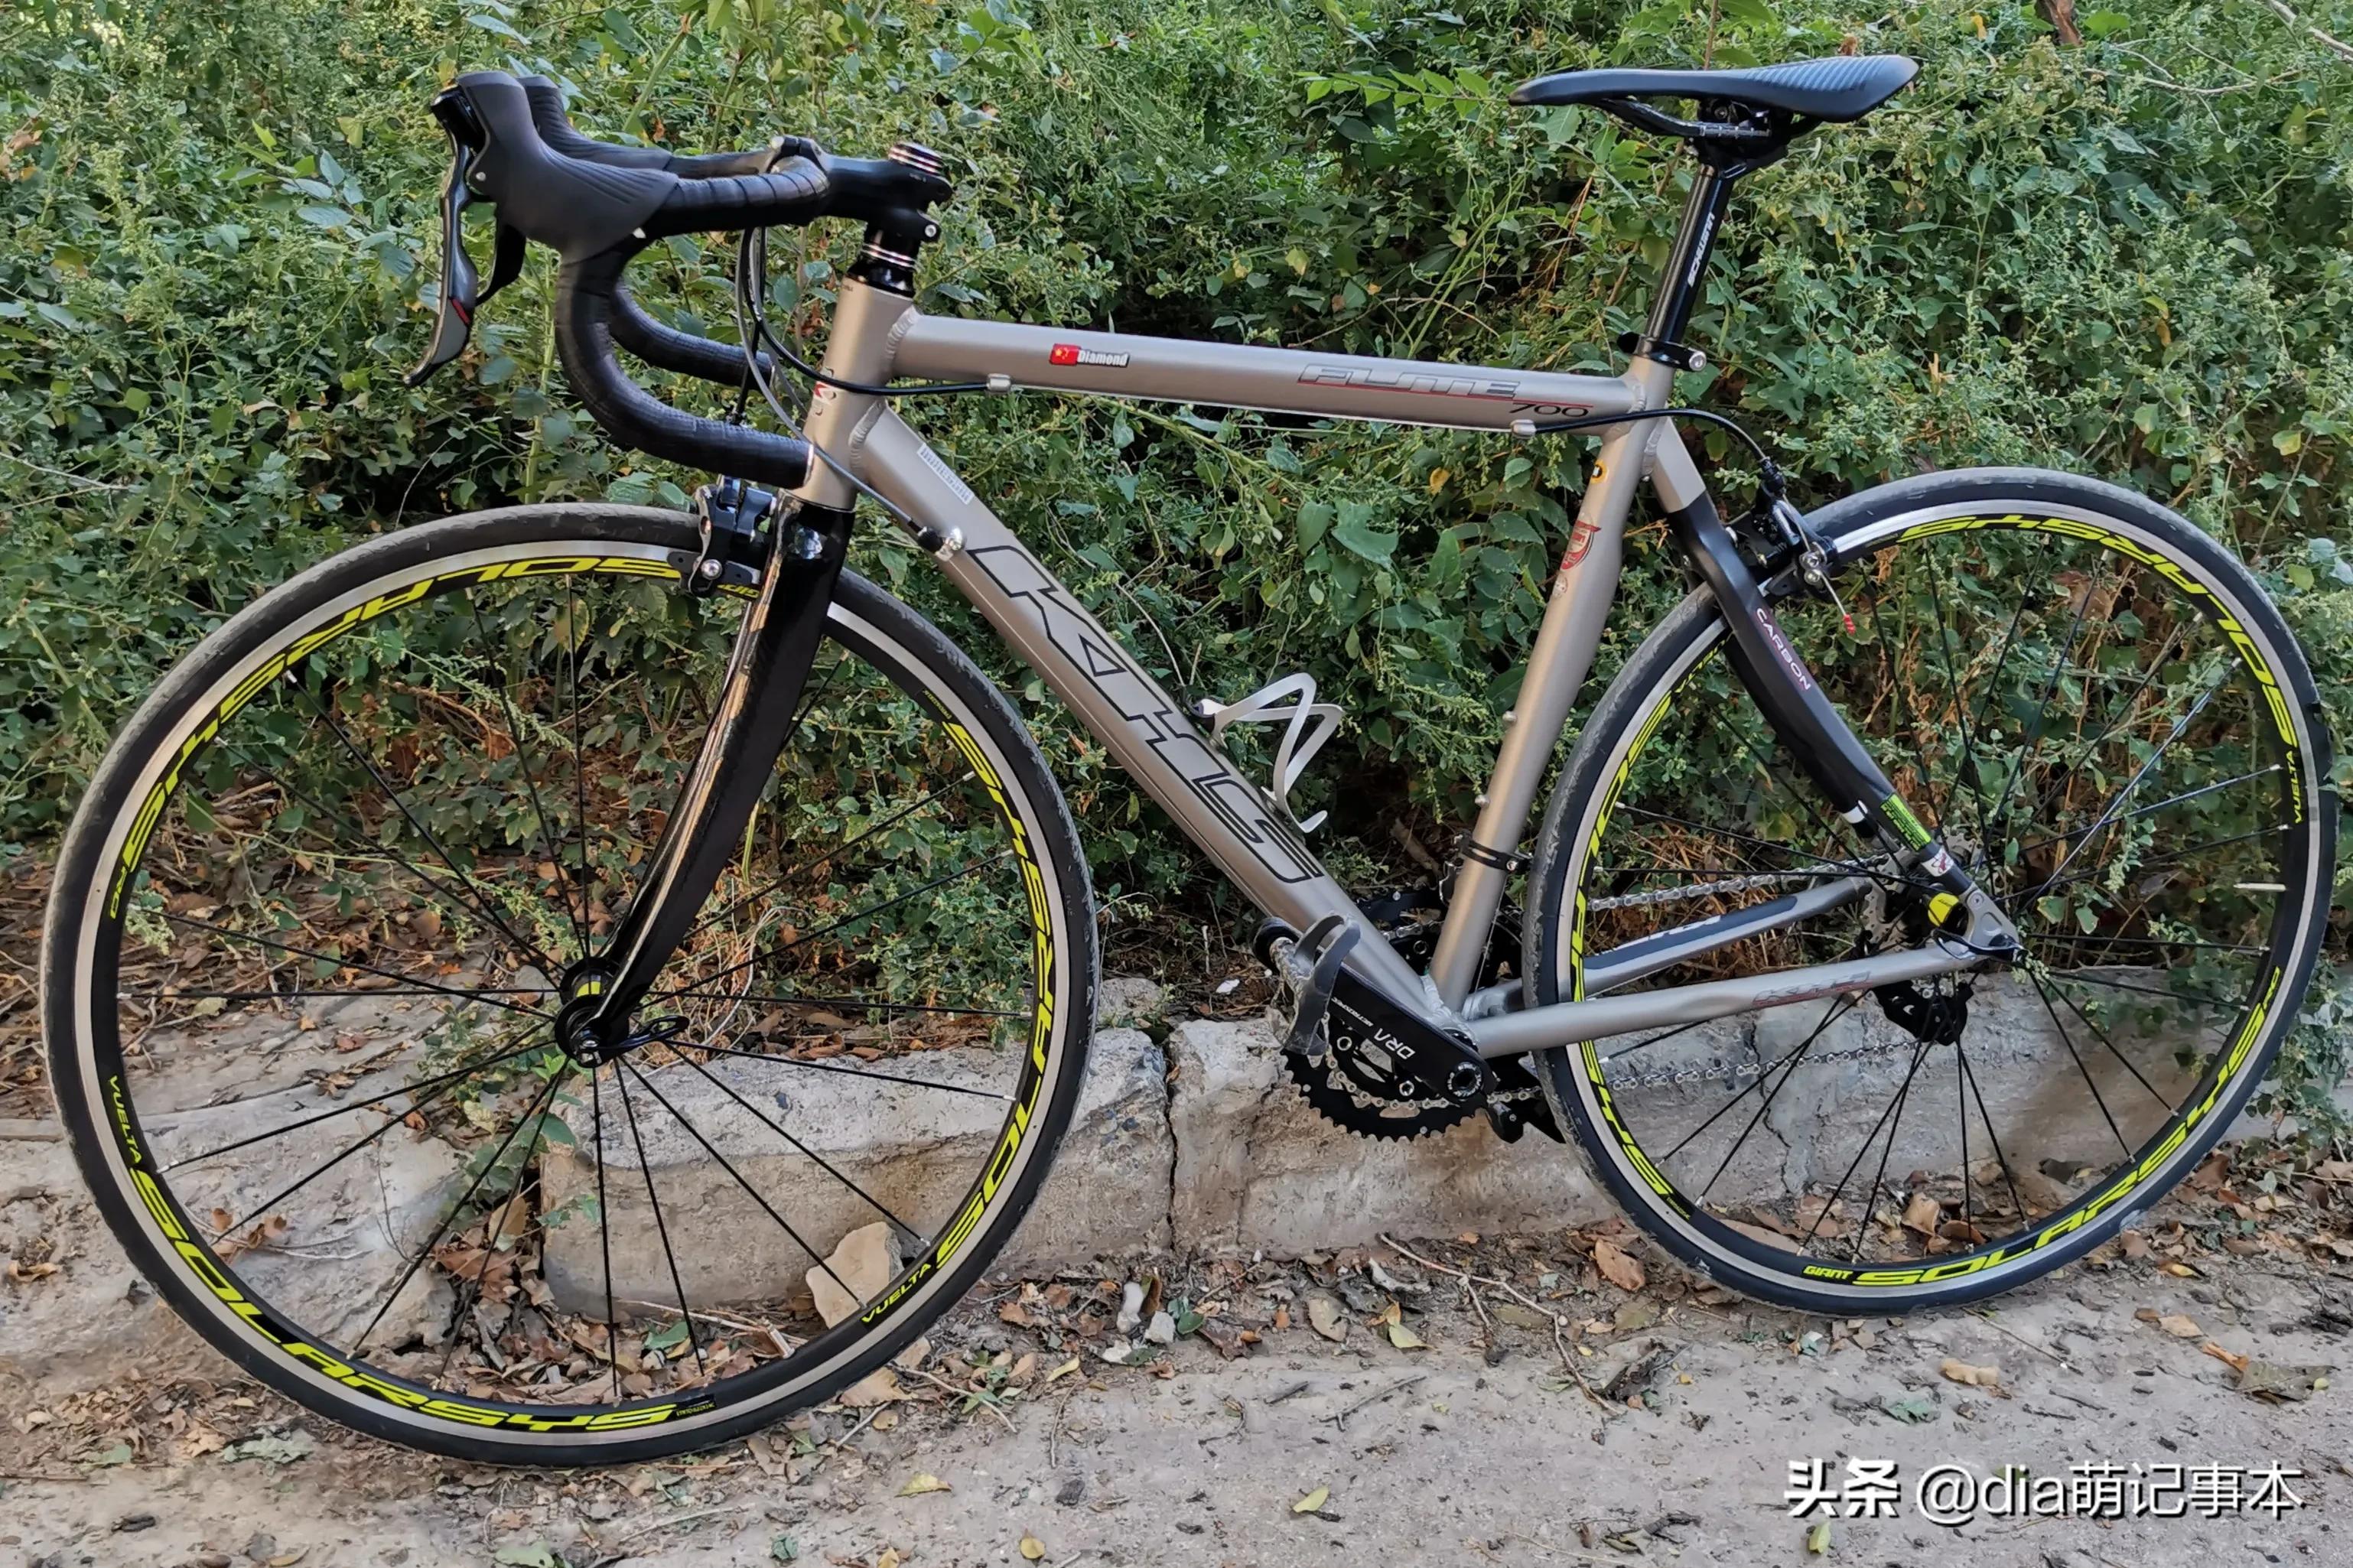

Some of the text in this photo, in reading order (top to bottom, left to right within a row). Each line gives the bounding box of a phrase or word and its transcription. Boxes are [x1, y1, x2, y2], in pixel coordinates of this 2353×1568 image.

[1077, 350, 1129, 367] Diamond
[1508, 402, 1589, 418] 700
[1756, 608, 1811, 690] CARBON
[2286, 750, 2303, 824] VUELTA
[109, 1075, 142, 1164] VUELTA
[861, 1262, 931, 1324] VUELTA
[1803, 1264, 1854, 1280] GIANT
